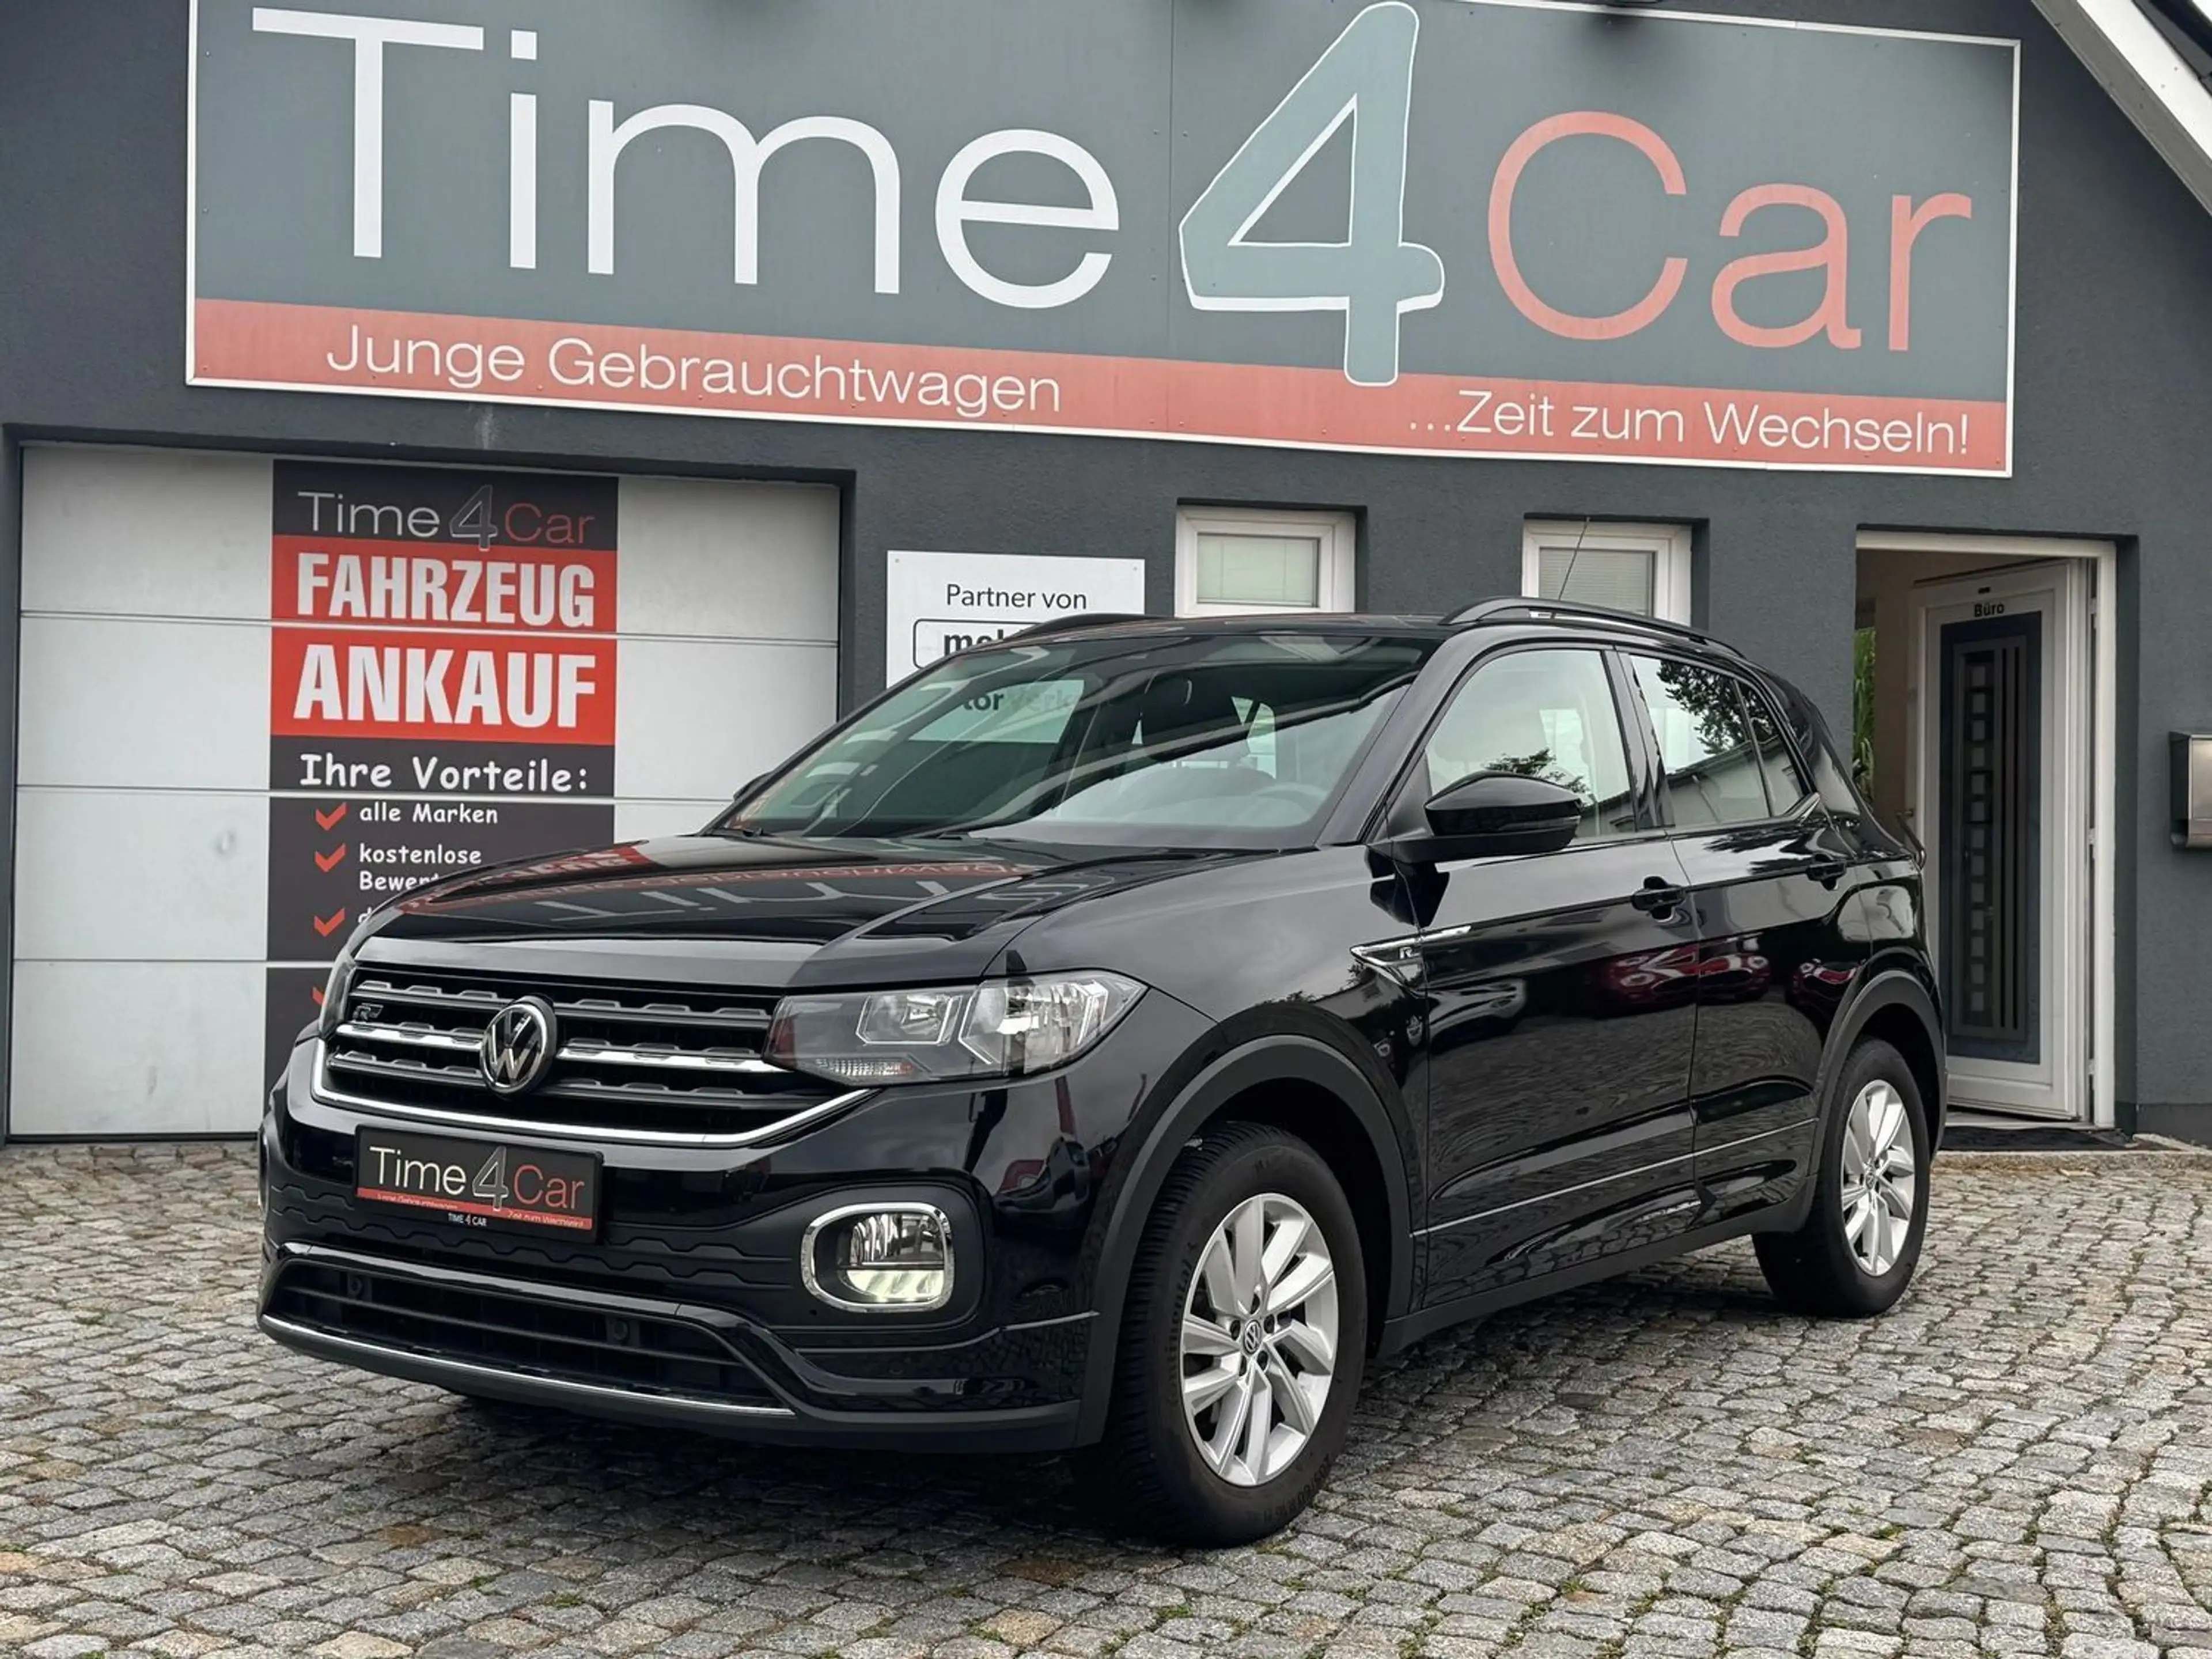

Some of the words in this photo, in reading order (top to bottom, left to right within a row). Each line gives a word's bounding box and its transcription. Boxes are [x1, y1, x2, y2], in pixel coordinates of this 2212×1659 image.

[327, 324, 525, 389] Junge
[548, 338, 1060, 416] Gebrauchtwagen
[1571, 405, 1684, 442] zum
[1704, 402, 1969, 454] Wechseln!
[297, 552, 594, 627] FAHRZEUG
[946, 584, 1035, 608] Partner
[1042, 592, 1086, 609] von
[1975, 603, 2005, 617] Büro
[293, 644, 595, 728] ANKAUF
[300, 753, 392, 787] Ihre
[412, 756, 587, 792] Vorteile:
[359, 802, 402, 822] alle
[412, 804, 498, 824] Marken
[359, 843, 482, 864] kostenlose
